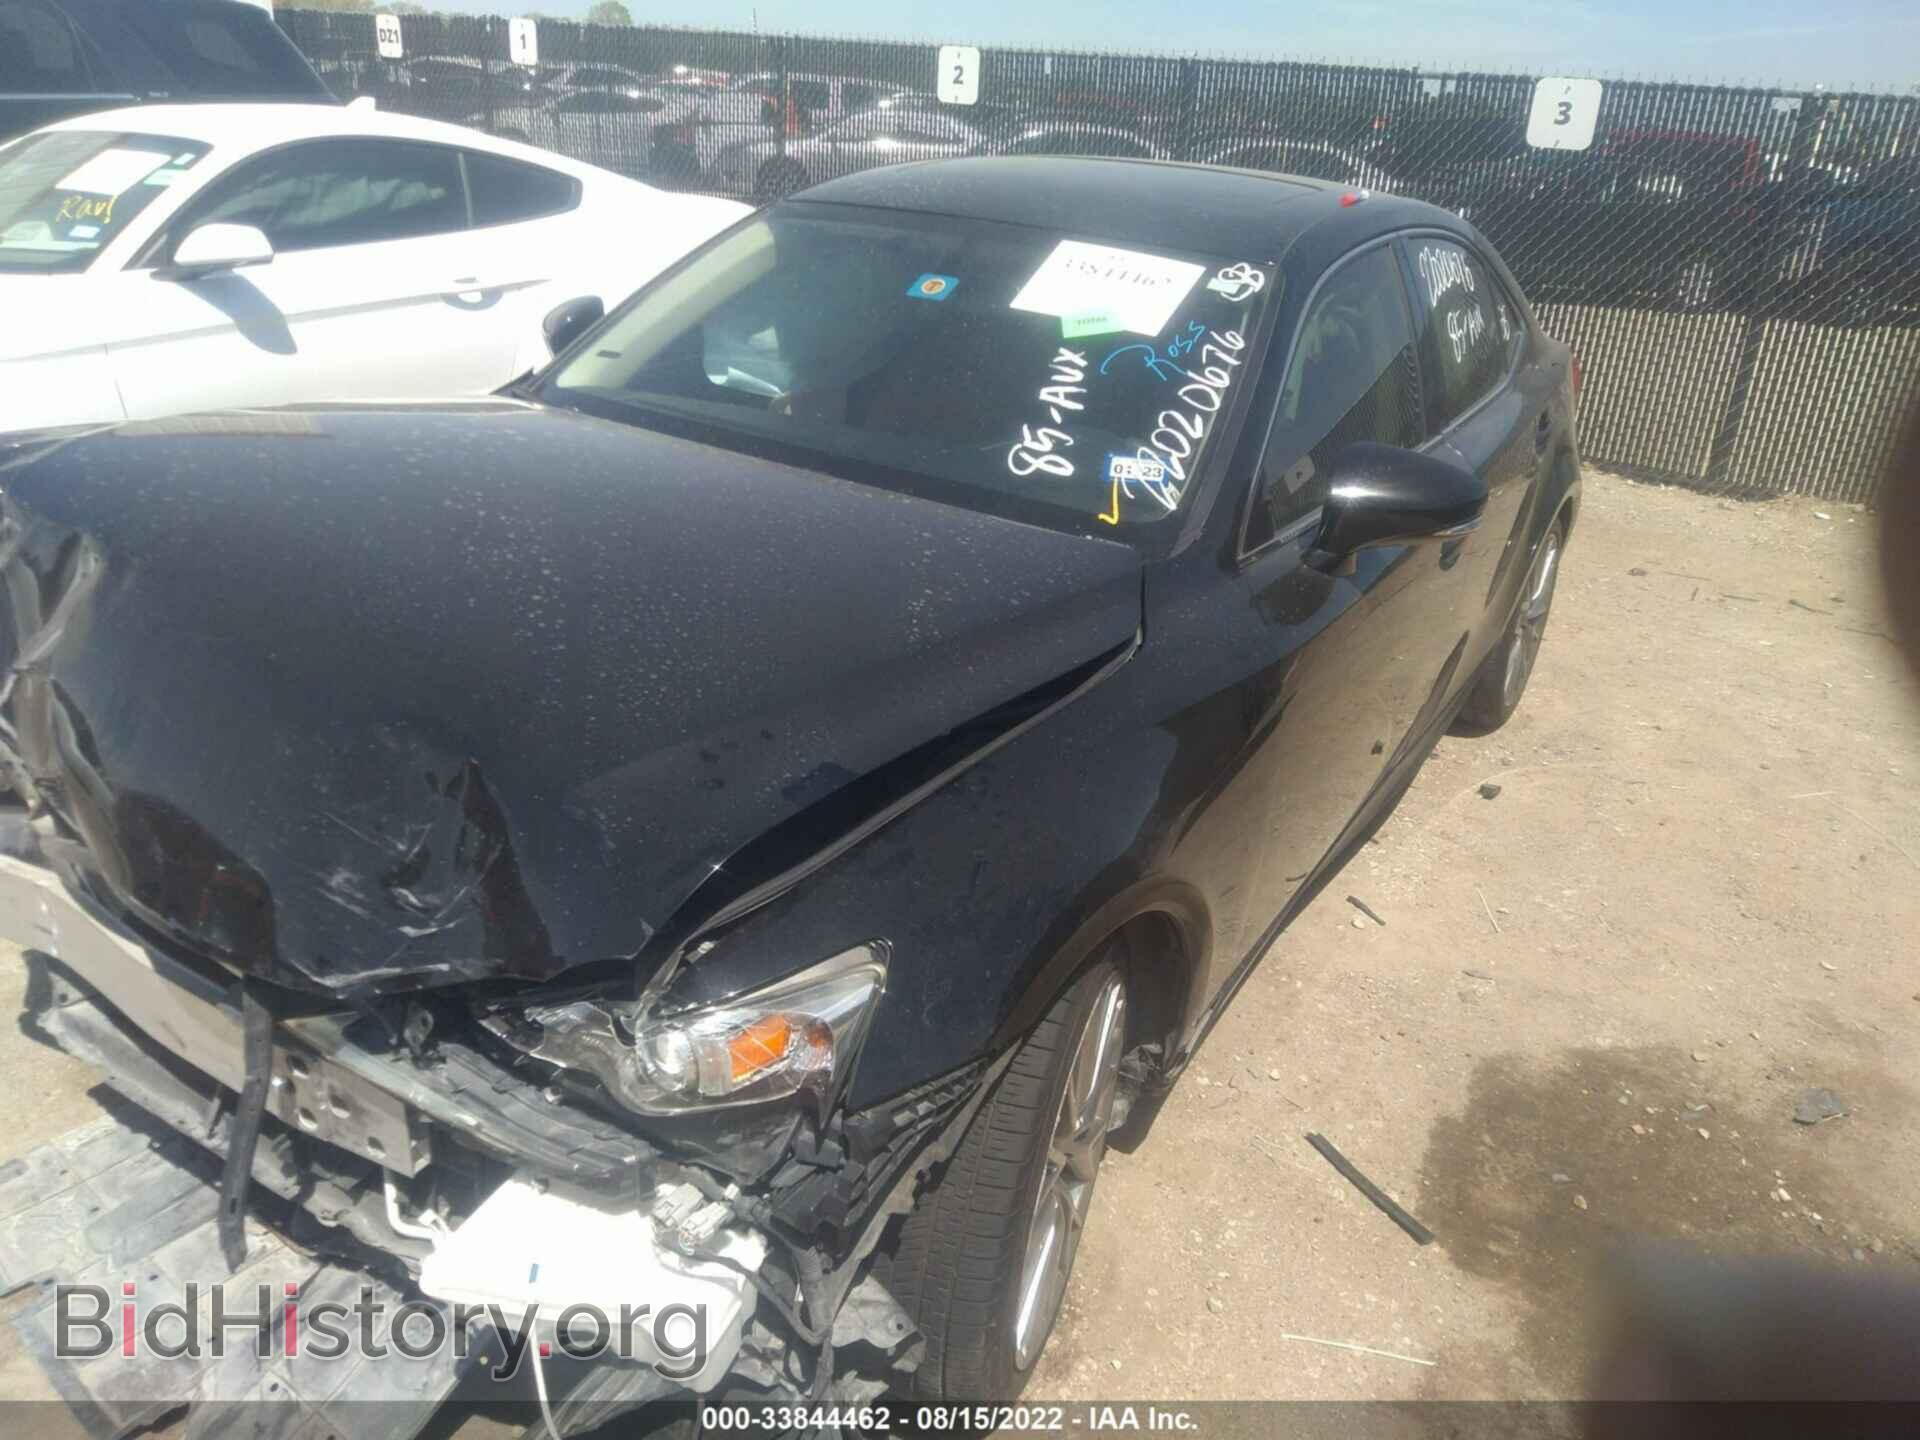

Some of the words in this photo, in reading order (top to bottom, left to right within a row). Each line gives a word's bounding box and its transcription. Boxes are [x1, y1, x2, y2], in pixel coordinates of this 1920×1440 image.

[520, 33, 527, 50] 1
[952, 65, 964, 85] 2
[1553, 101, 1573, 126] 3
